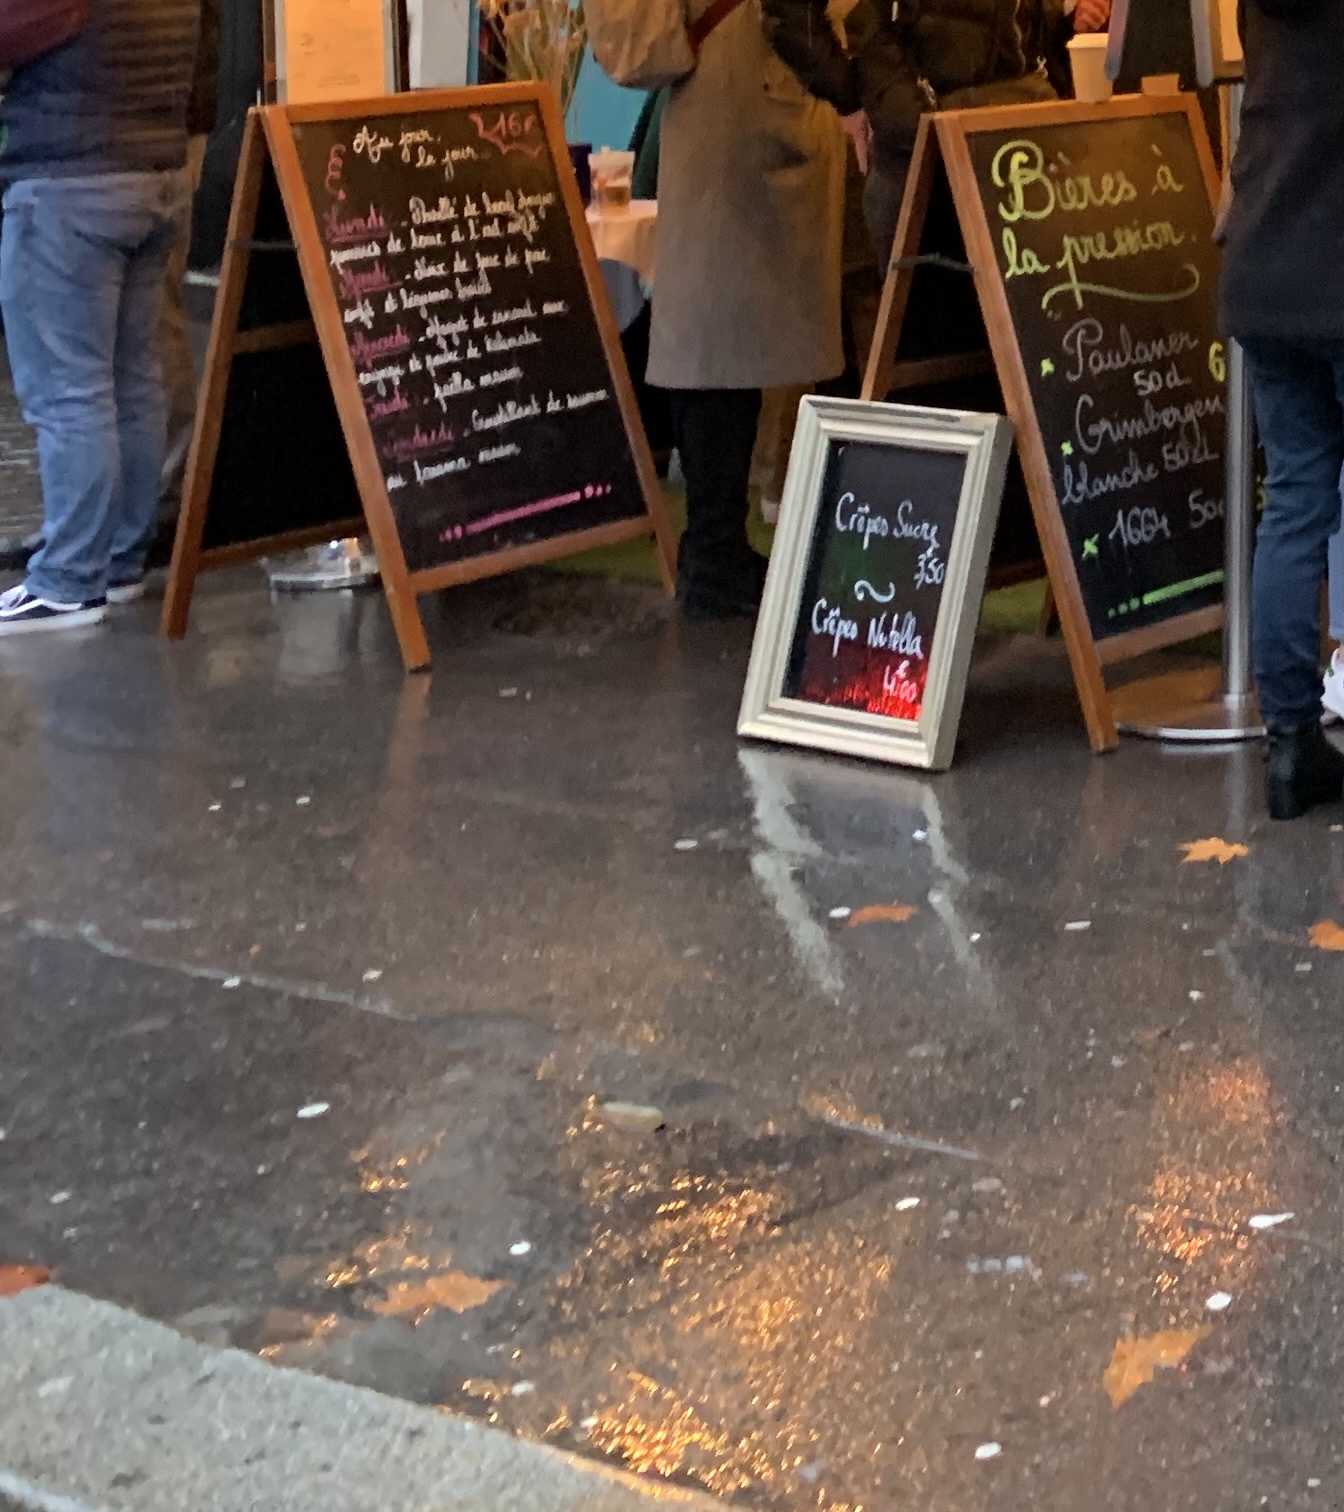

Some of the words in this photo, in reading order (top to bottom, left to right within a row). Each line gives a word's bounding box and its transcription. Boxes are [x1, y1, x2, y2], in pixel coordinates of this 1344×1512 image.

[991, 139, 1137, 222] Bières
[1150, 143, 1184, 196] à
[1002, 225, 1051, 281] la
[1062, 317, 1199, 382] Paulaner
[835, 492, 889, 551] Crêpes
[1108, 505, 1172, 547] 1664
[811, 598, 858, 659] Crêpes
[867, 610, 925, 660] Nutella
